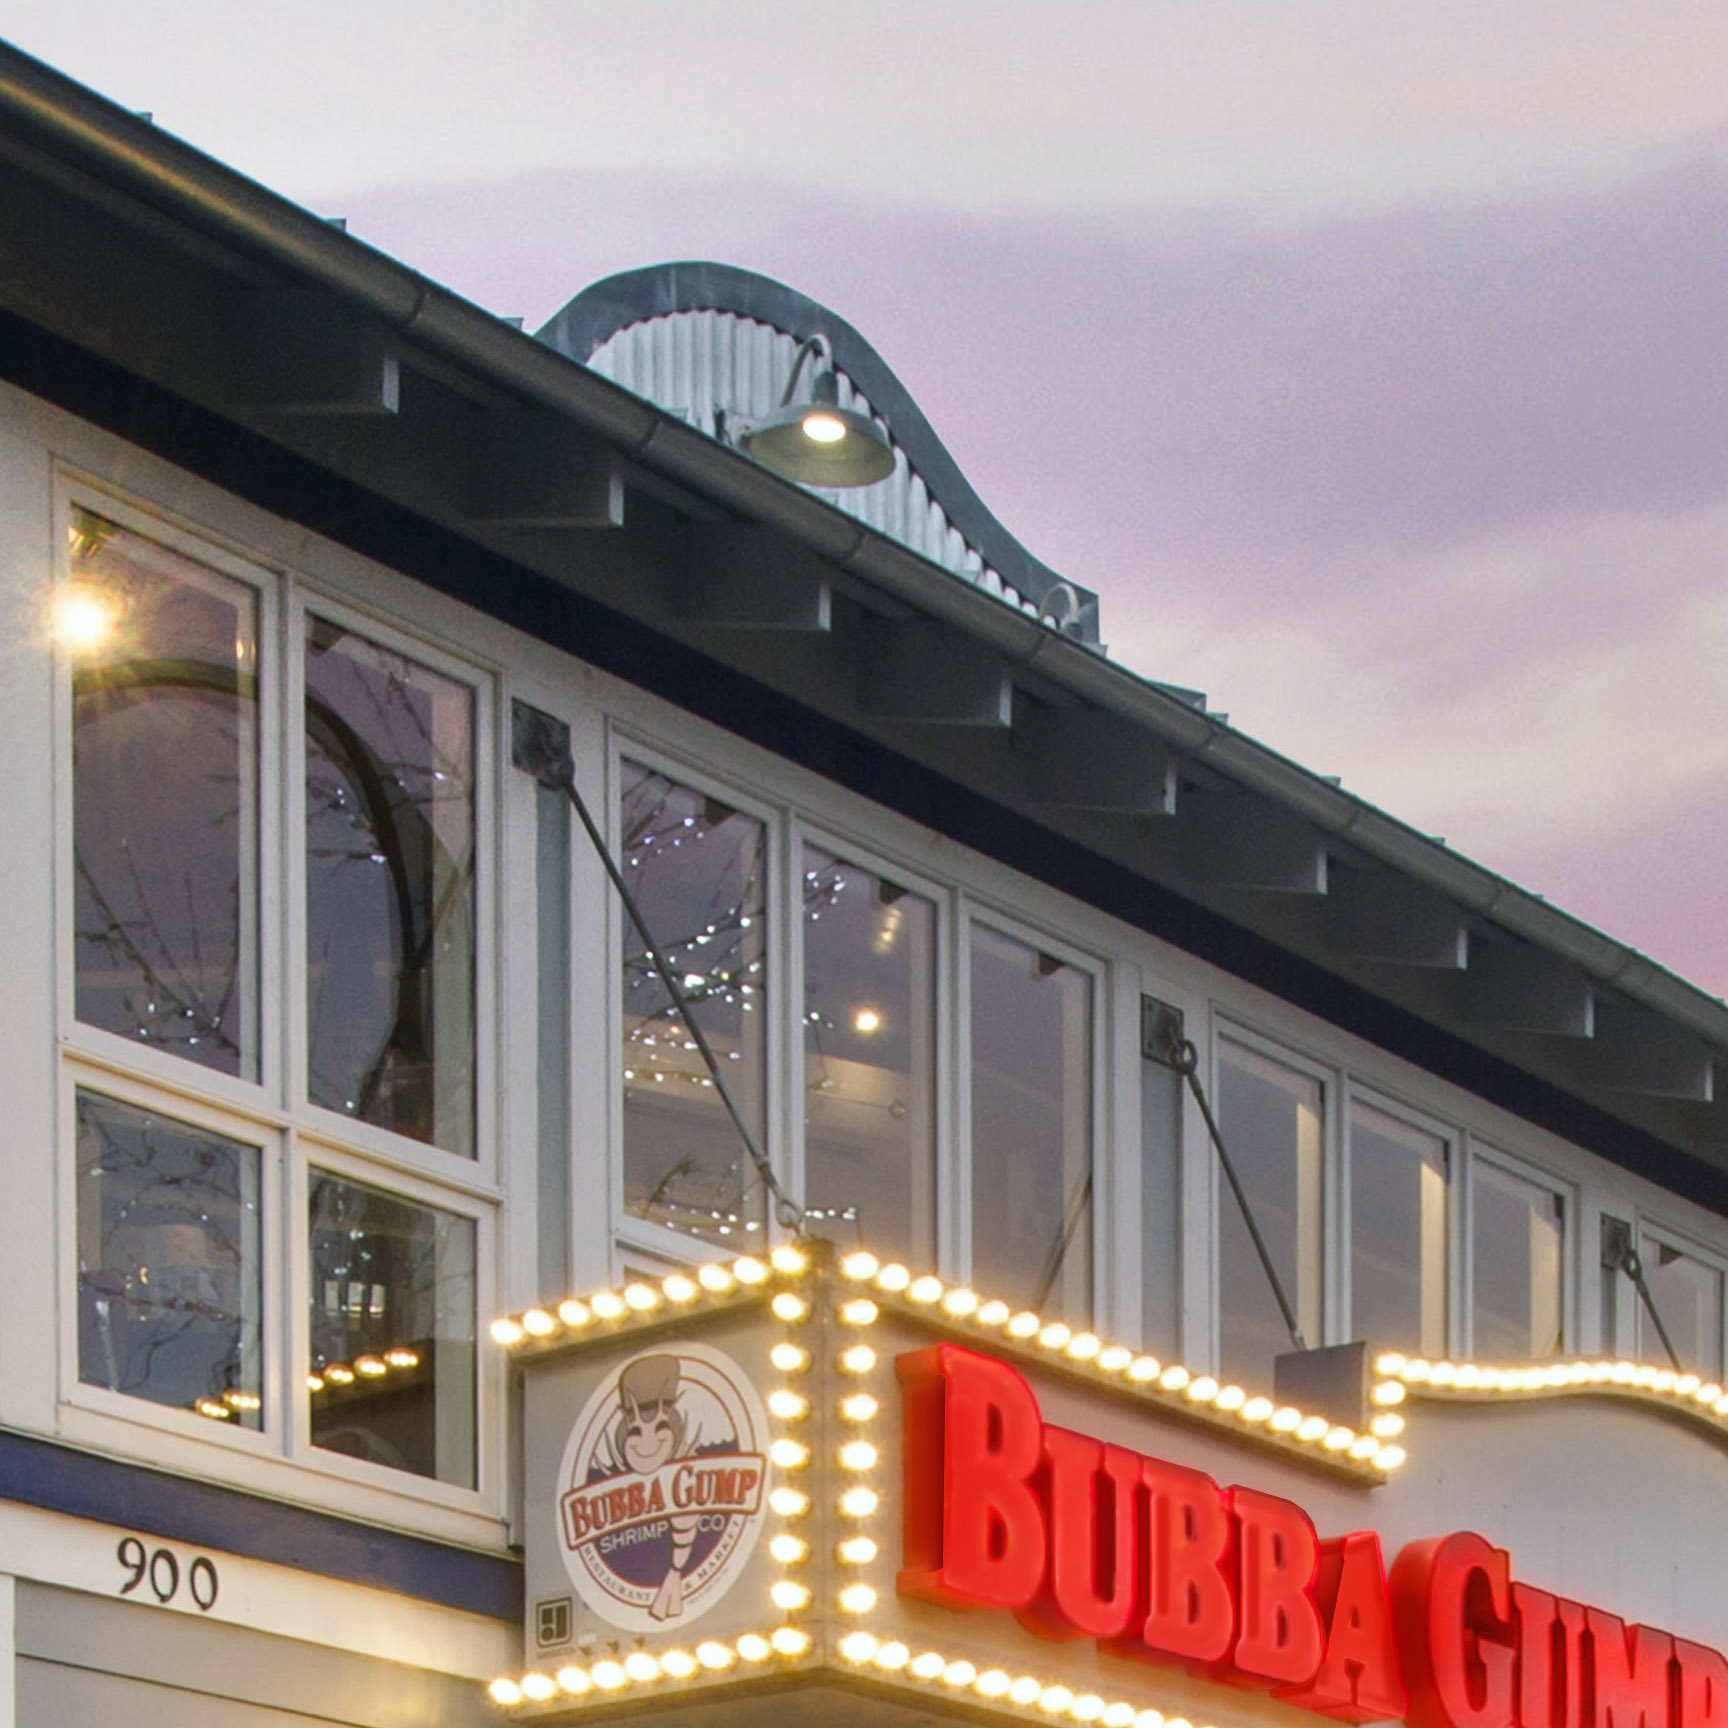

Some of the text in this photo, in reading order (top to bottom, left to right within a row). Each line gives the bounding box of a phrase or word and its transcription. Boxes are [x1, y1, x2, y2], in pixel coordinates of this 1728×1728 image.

[569, 1463, 759, 1541] BUBBA GUMP
[599, 1514, 726, 1554] SHRIMP CO
[896, 1343, 1408, 1722] BUBBA
[117, 1536, 219, 1611] 900
[584, 1545, 652, 1601] RESTAURANT
